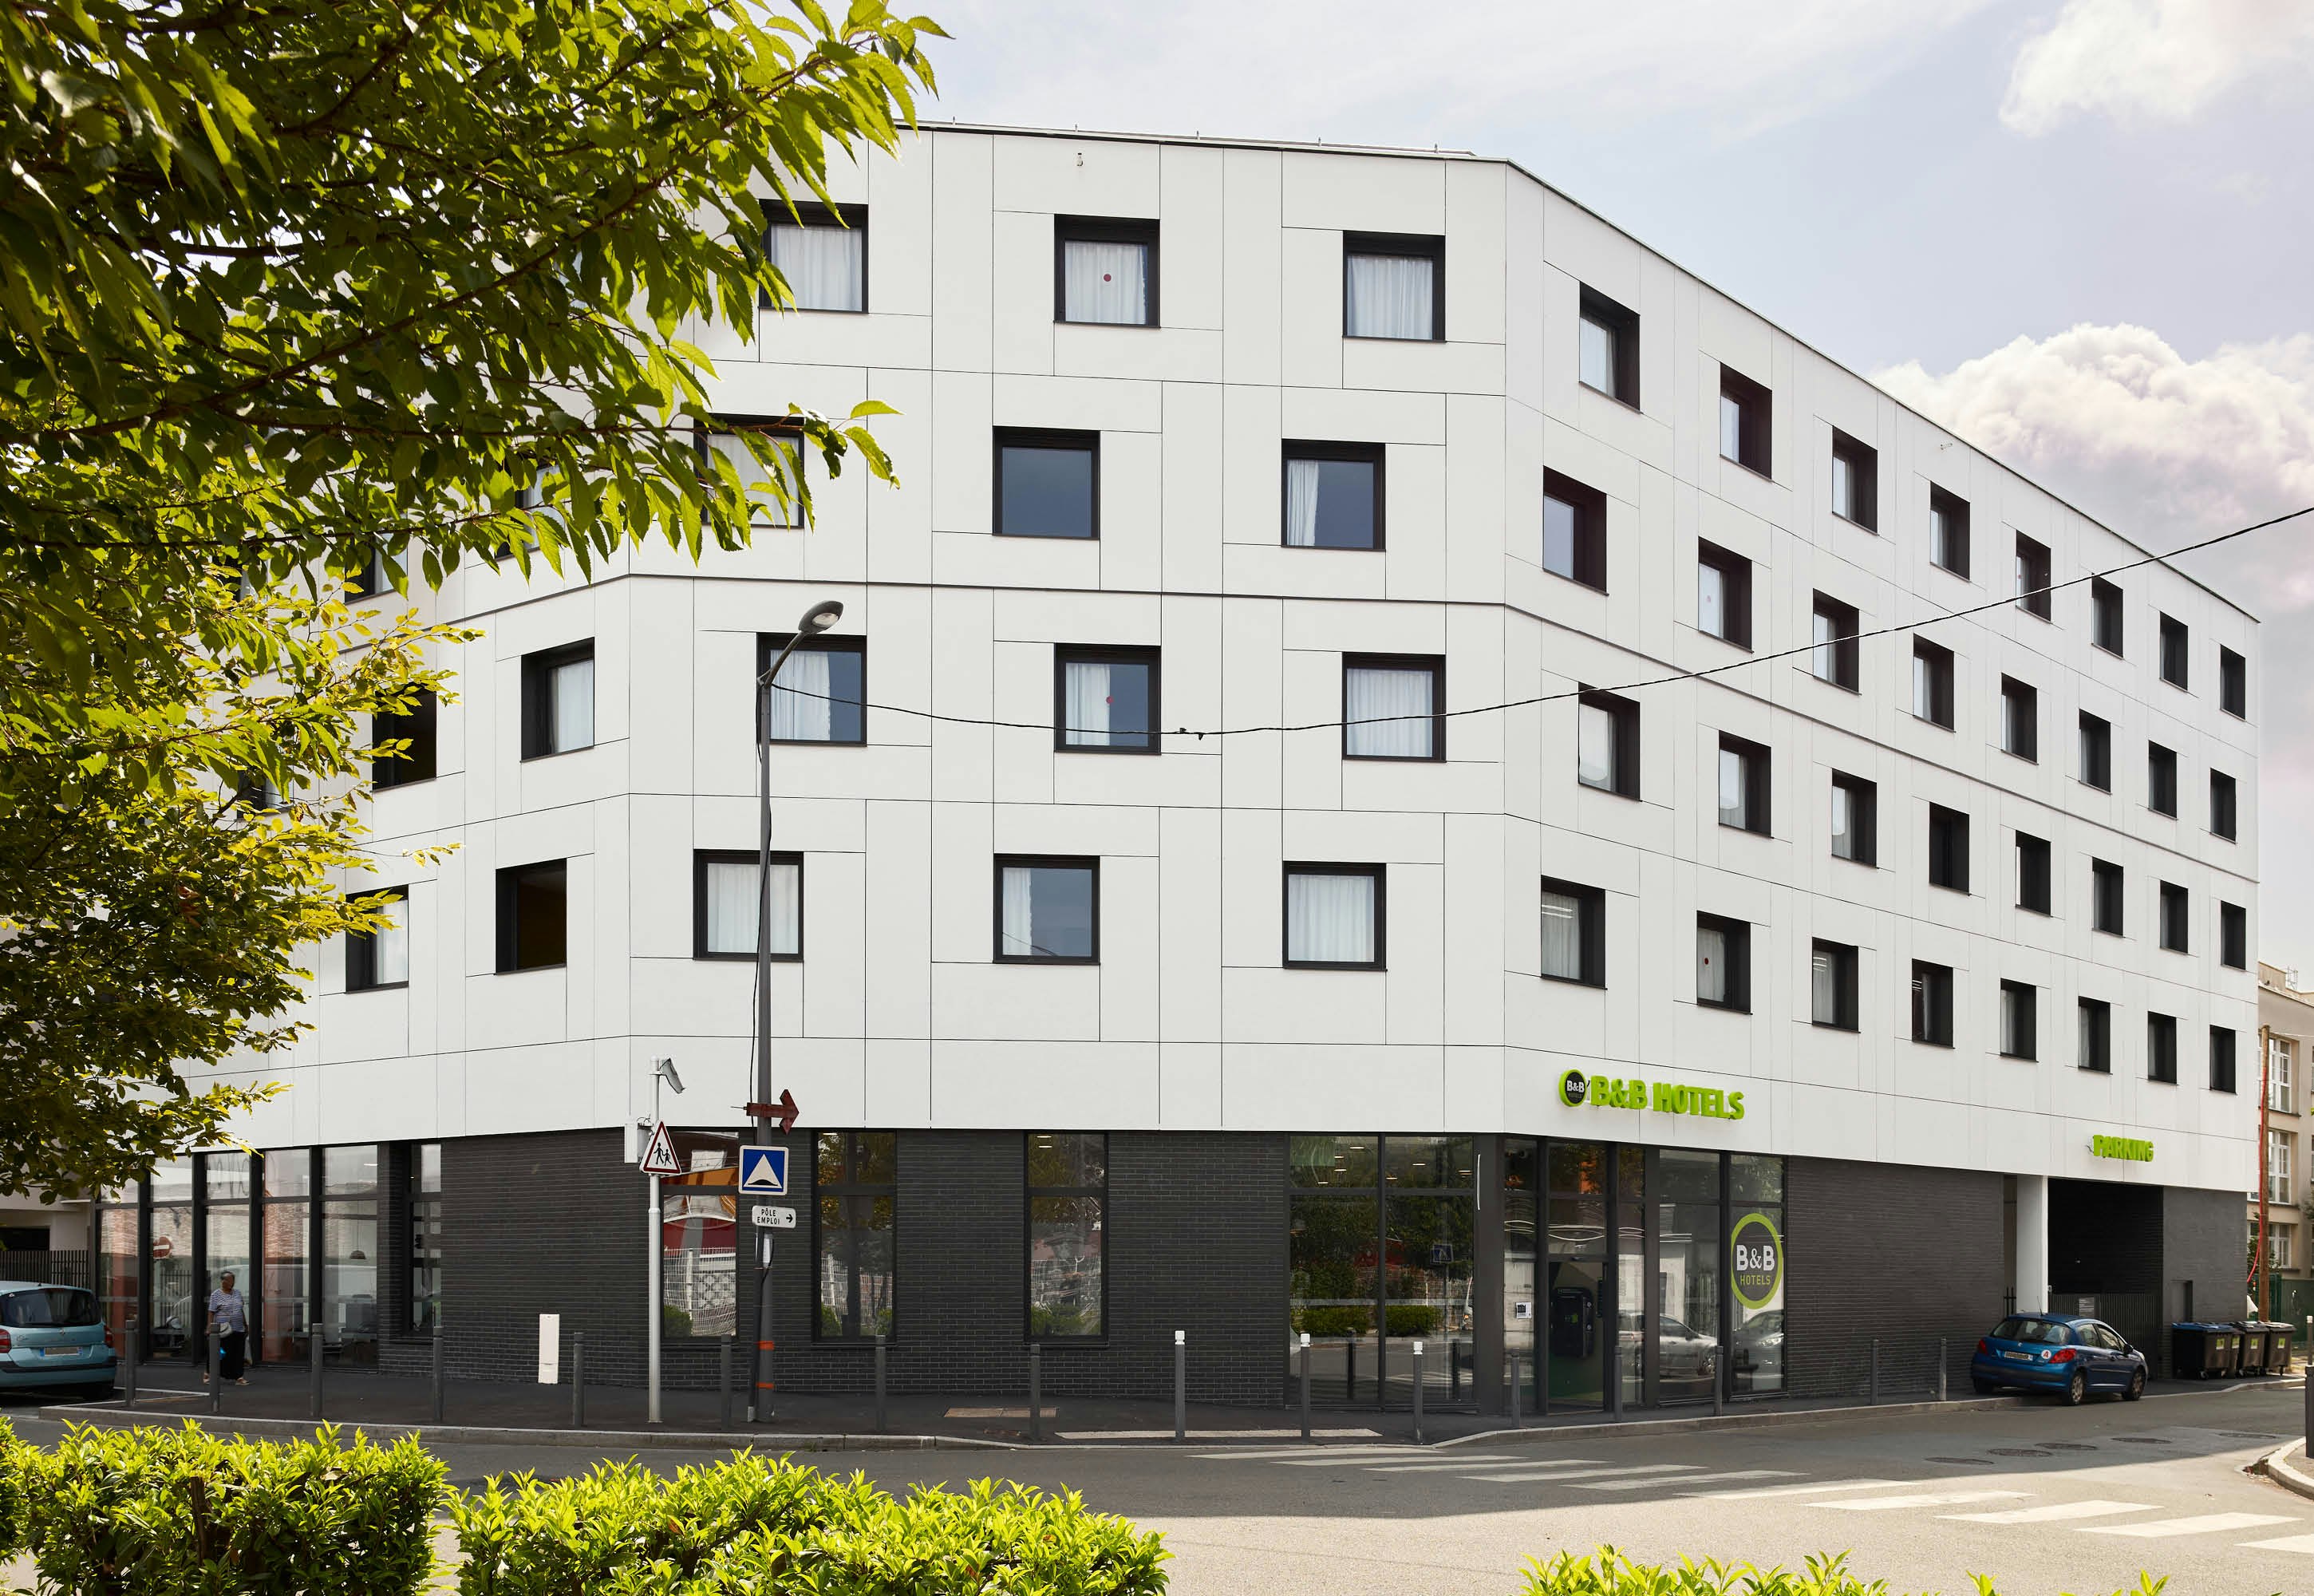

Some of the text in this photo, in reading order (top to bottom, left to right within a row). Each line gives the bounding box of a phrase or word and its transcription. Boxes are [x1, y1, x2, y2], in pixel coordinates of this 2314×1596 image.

[1566, 1080, 1585, 1093] B&B
[1590, 1076, 1744, 1120] B&B HOTELS
[2093, 1134, 2154, 1162] PARKING
[757, 1216, 780, 1225] EMPLOI
[1736, 1245, 1775, 1271] B&B
[1740, 1275, 1771, 1285] HOTELS
